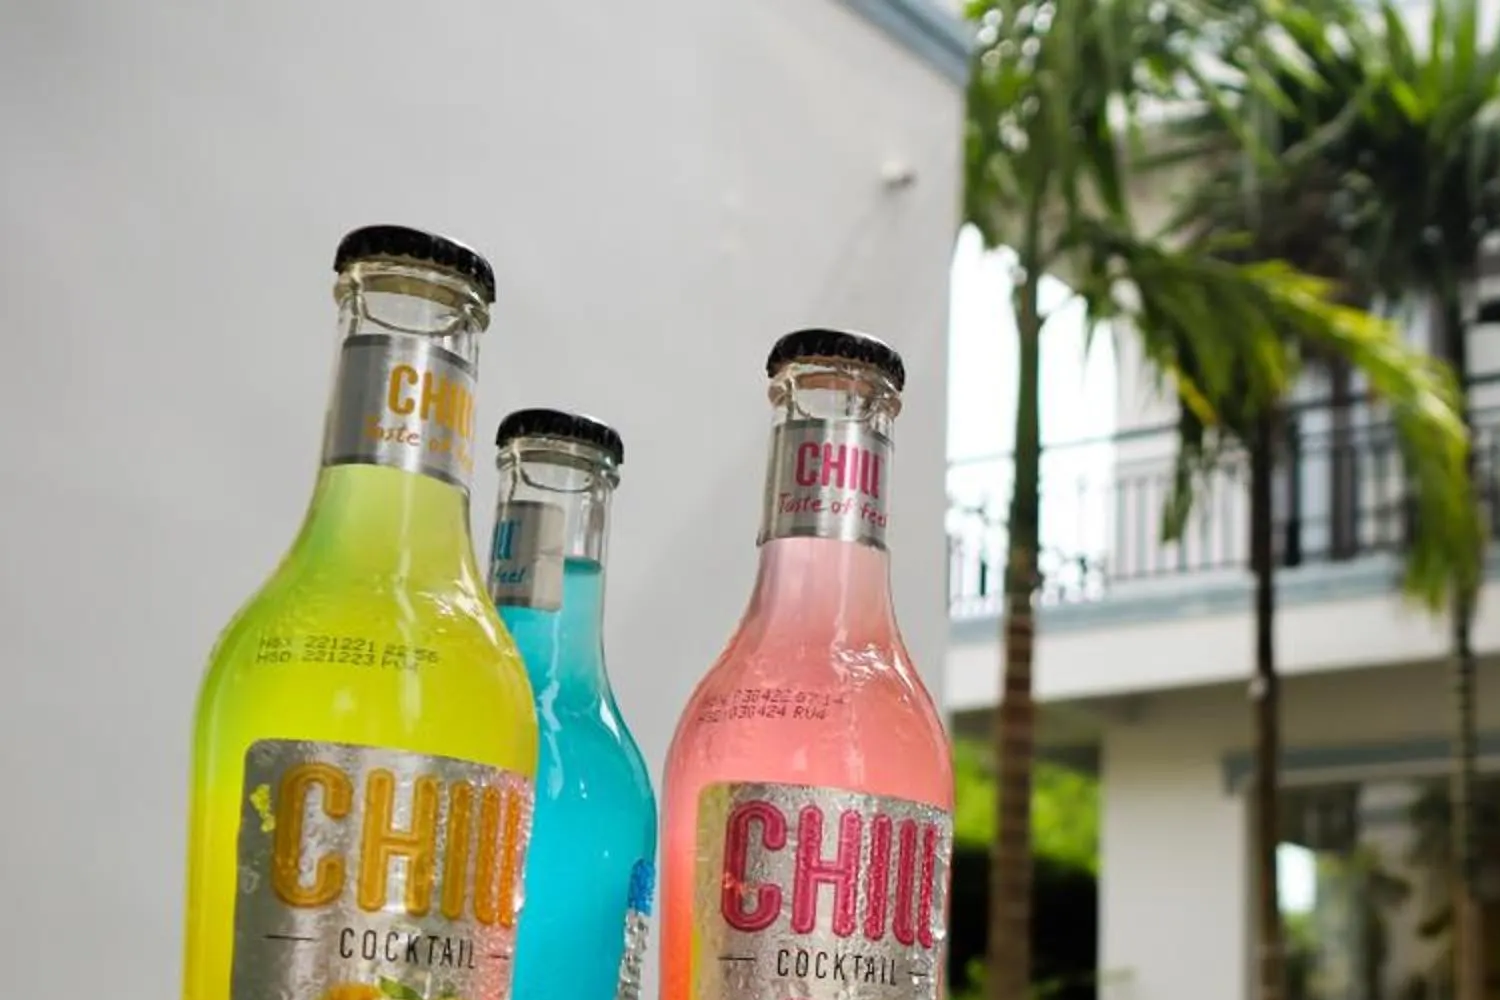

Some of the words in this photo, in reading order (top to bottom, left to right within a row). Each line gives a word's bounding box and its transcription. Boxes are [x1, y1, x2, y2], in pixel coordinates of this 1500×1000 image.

[795, 441, 880, 500] CHILL
[271, 761, 523, 929] CHILL
[721, 800, 938, 950] CHILL
[339, 927, 477, 970] COCKTAIL
[776, 948, 898, 987] COCKTAIL
